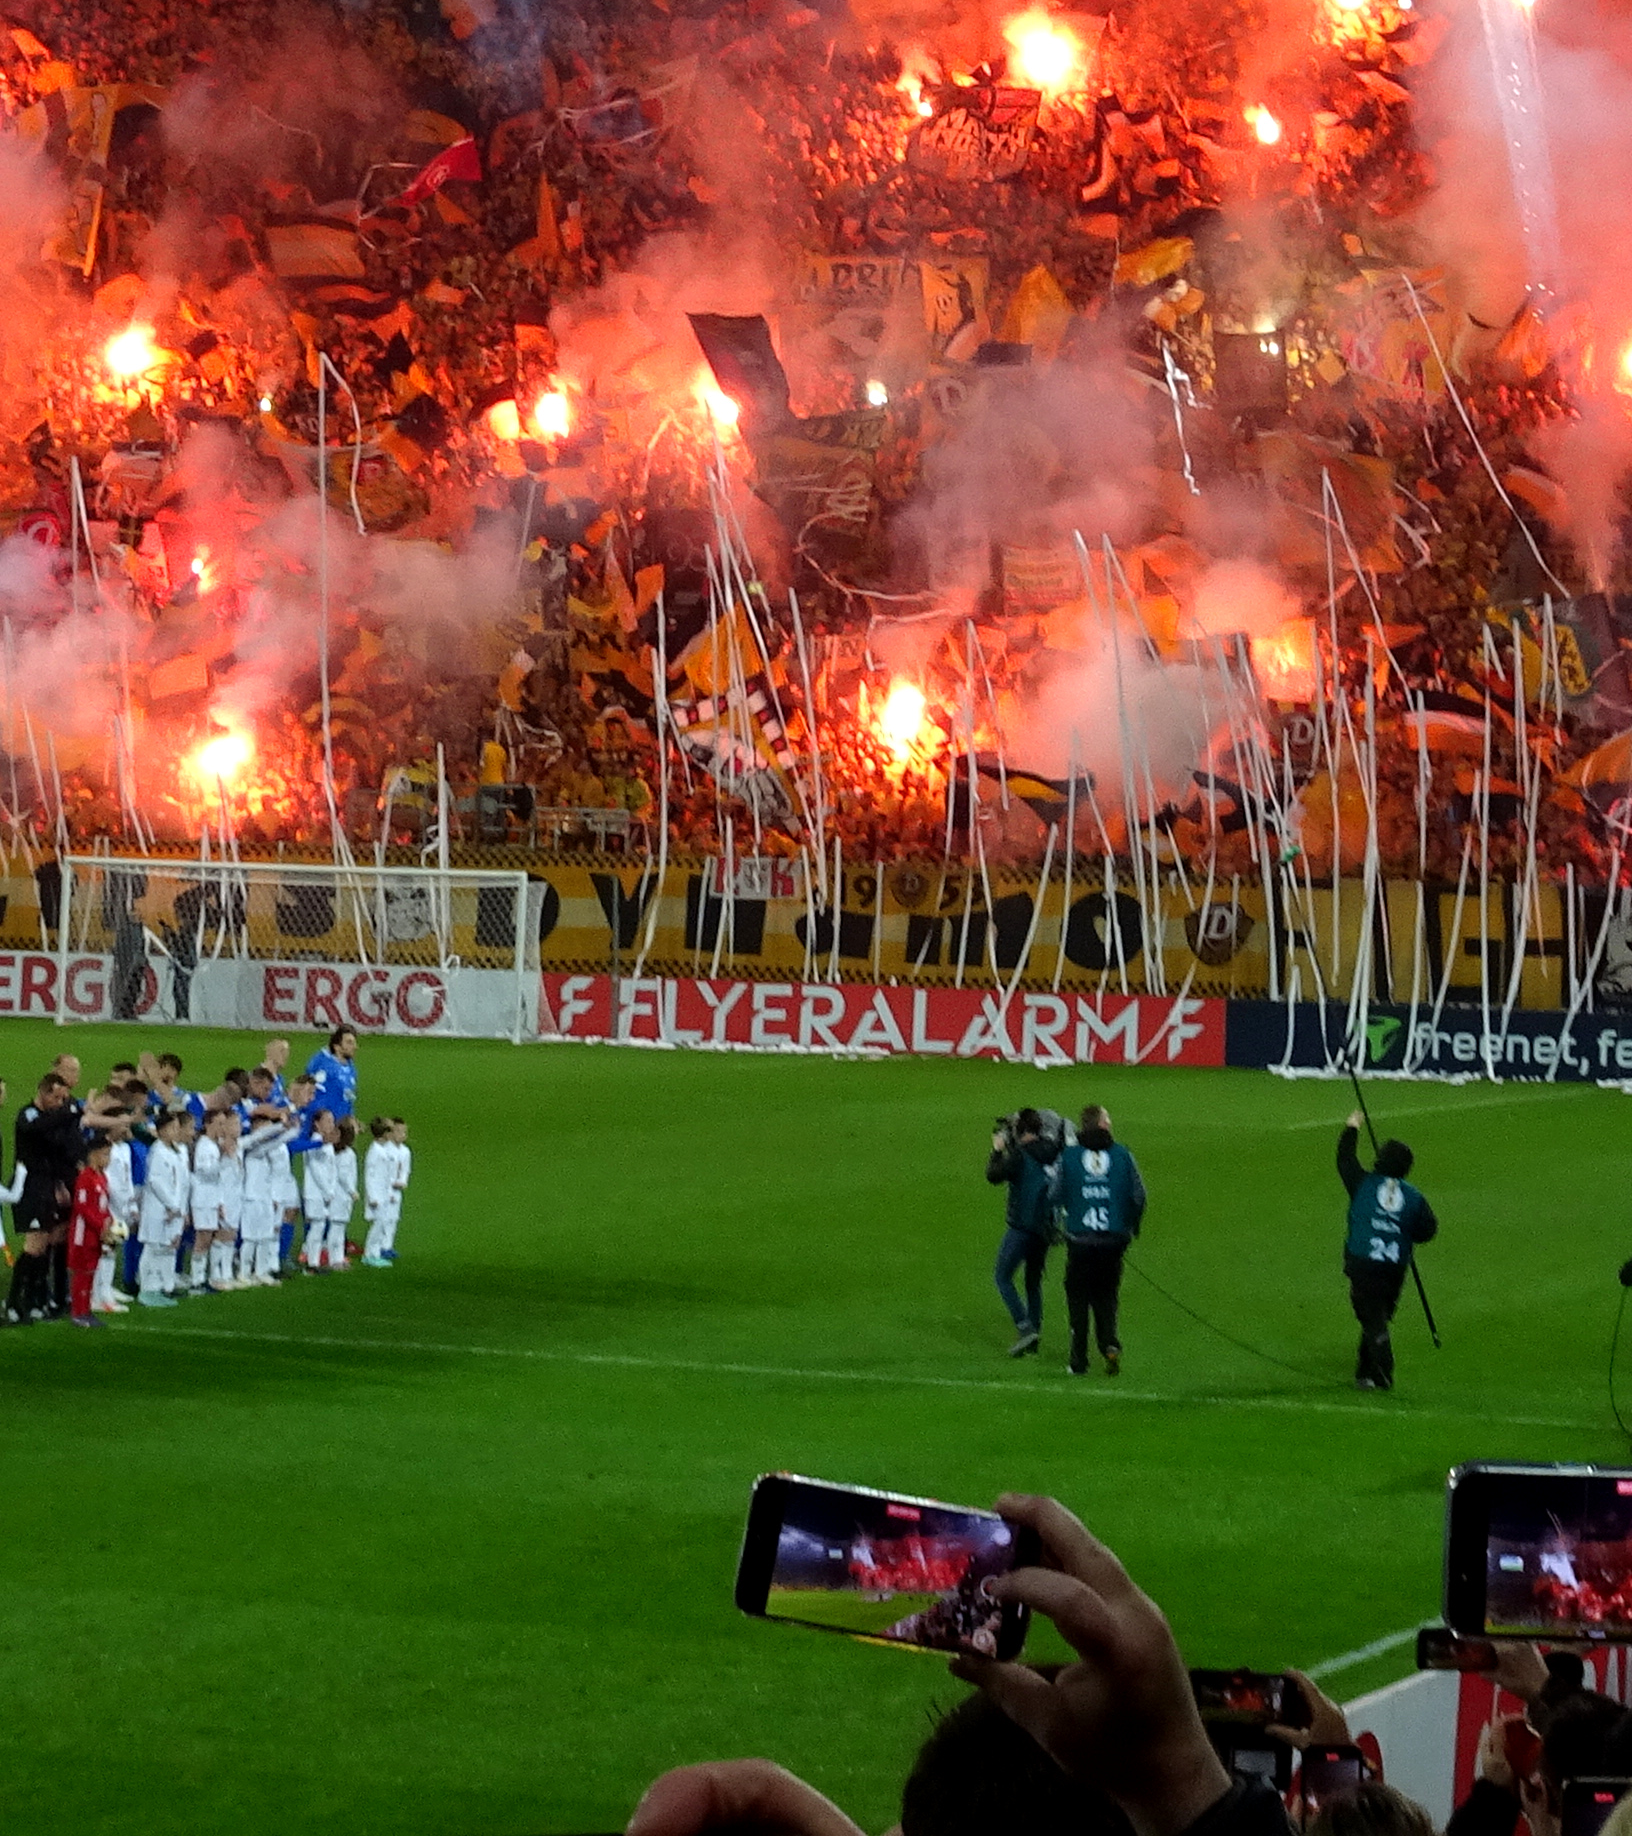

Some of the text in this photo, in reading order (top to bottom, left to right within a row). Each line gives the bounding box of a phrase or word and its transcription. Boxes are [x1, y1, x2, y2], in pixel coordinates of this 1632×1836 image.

[262, 966, 446, 1029] ERGO
[617, 977, 1143, 1063] FLYERALARM
[1081, 1205, 1111, 1232] 45
[1368, 1236, 1401, 1264] 24
